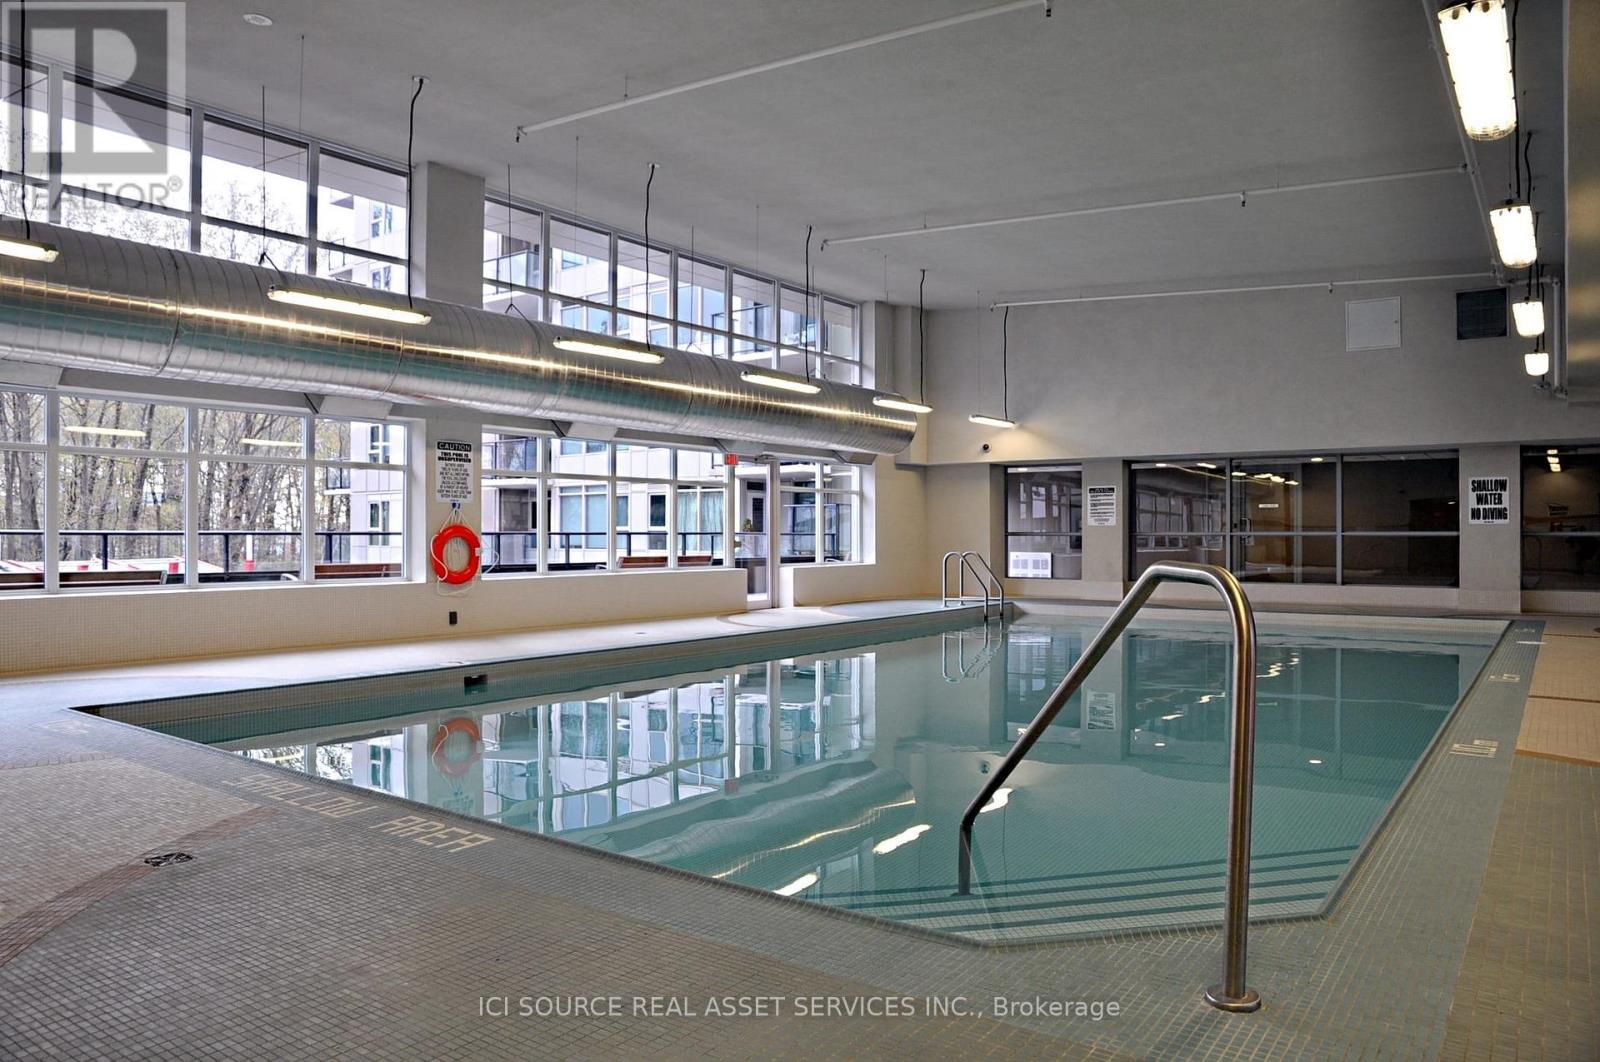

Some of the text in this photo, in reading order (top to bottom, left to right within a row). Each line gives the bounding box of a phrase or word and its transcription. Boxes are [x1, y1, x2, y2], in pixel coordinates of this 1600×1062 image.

[439, 442, 470, 451] CAUTION
[1471, 479, 1507, 492] SHALLOW
[1475, 493, 1503, 505] WATER
[1471, 507, 1508, 520] NO DIVING
[222, 773, 495, 853] SHALLOW AREA
